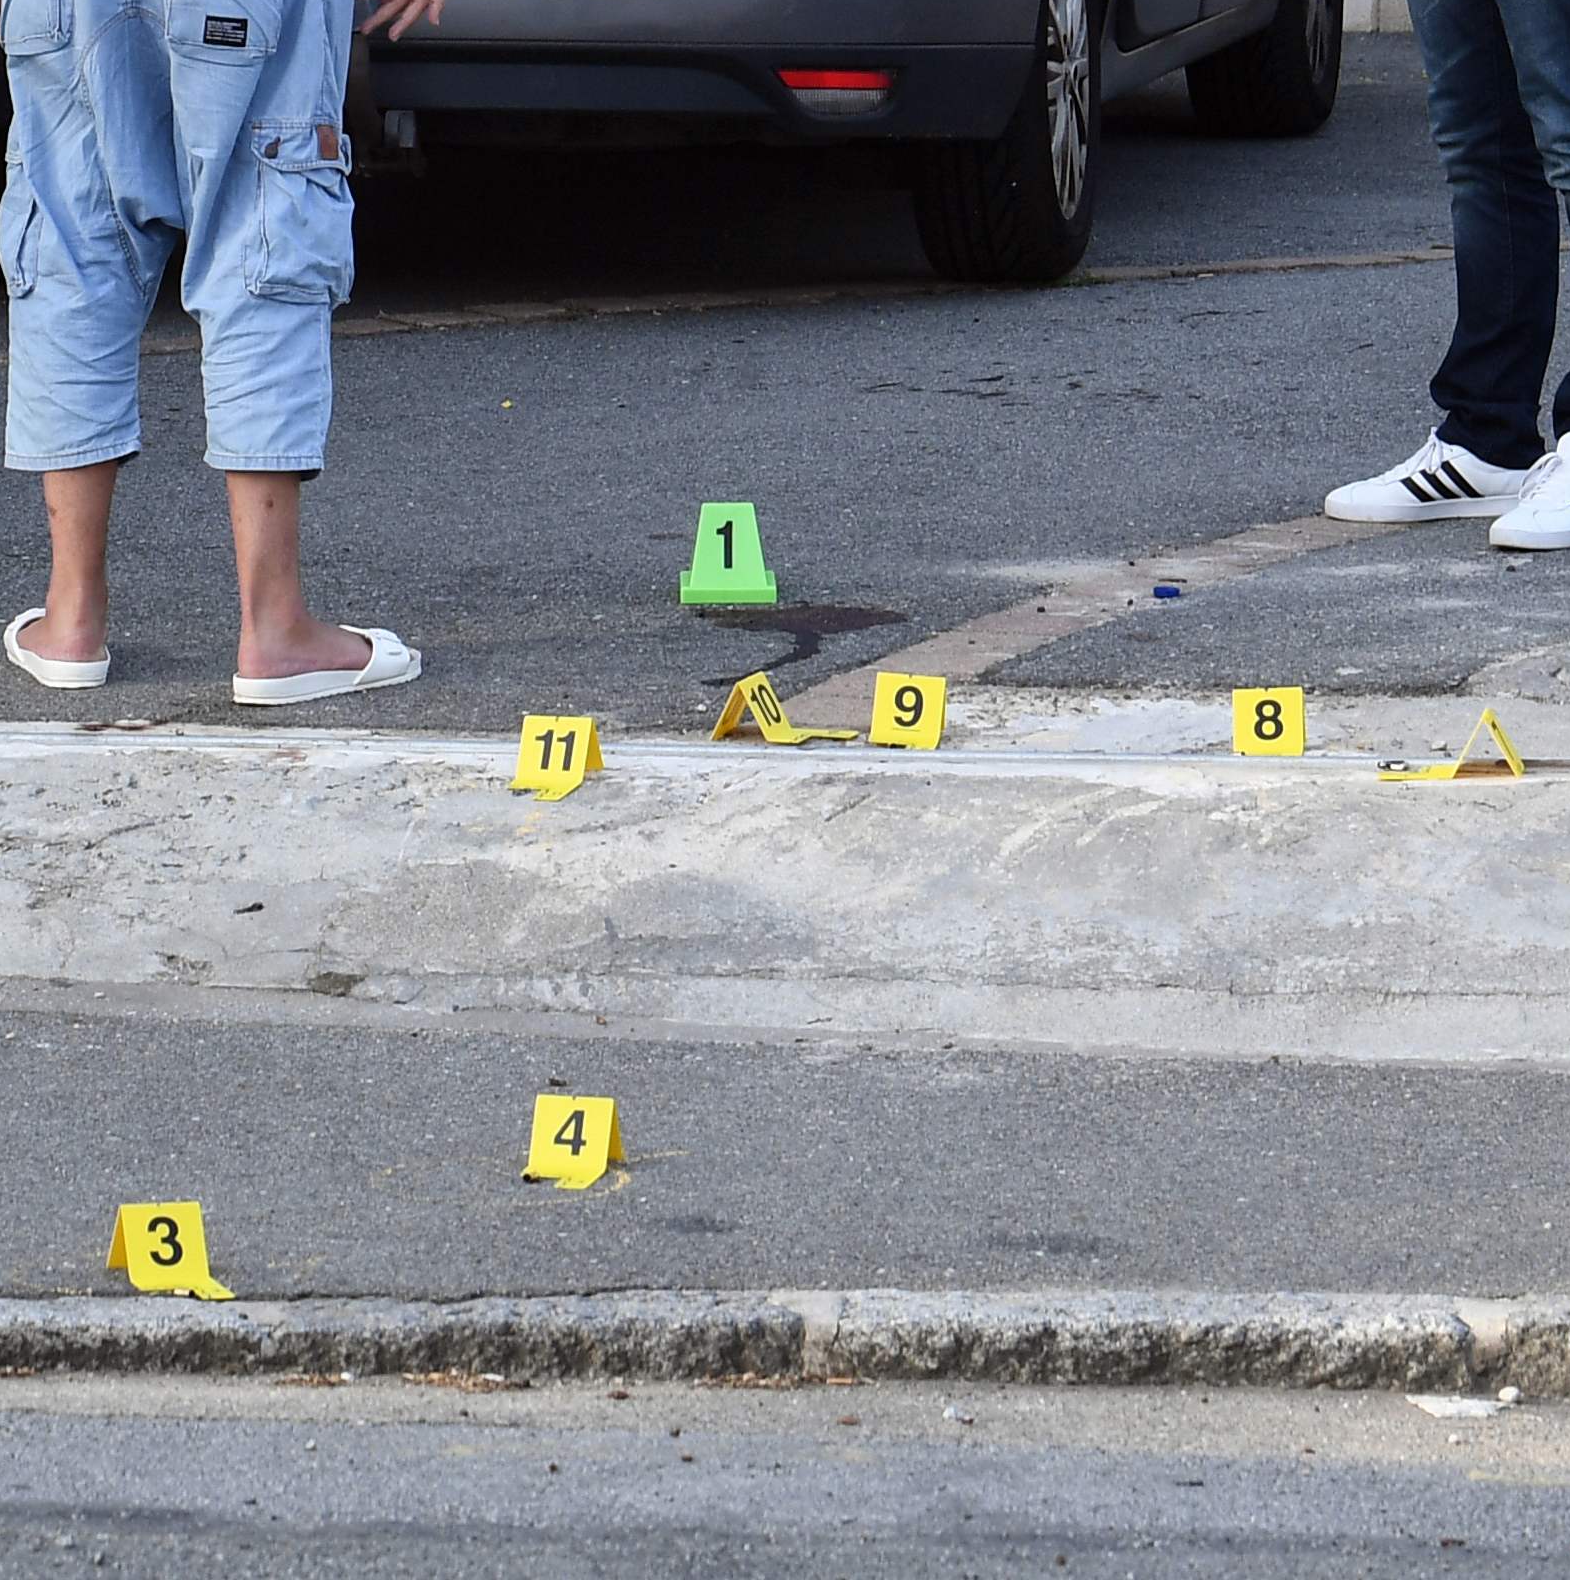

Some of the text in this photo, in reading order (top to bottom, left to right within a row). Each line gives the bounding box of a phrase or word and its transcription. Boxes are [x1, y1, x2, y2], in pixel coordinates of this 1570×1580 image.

[716, 520, 734, 569] 1
[749, 682, 783, 727] 10
[893, 684, 925, 728] 9
[1253, 699, 1284, 741] 8
[534, 728, 577, 772] 11
[552, 1108, 588, 1157] 4
[146, 1215, 184, 1267] 3
